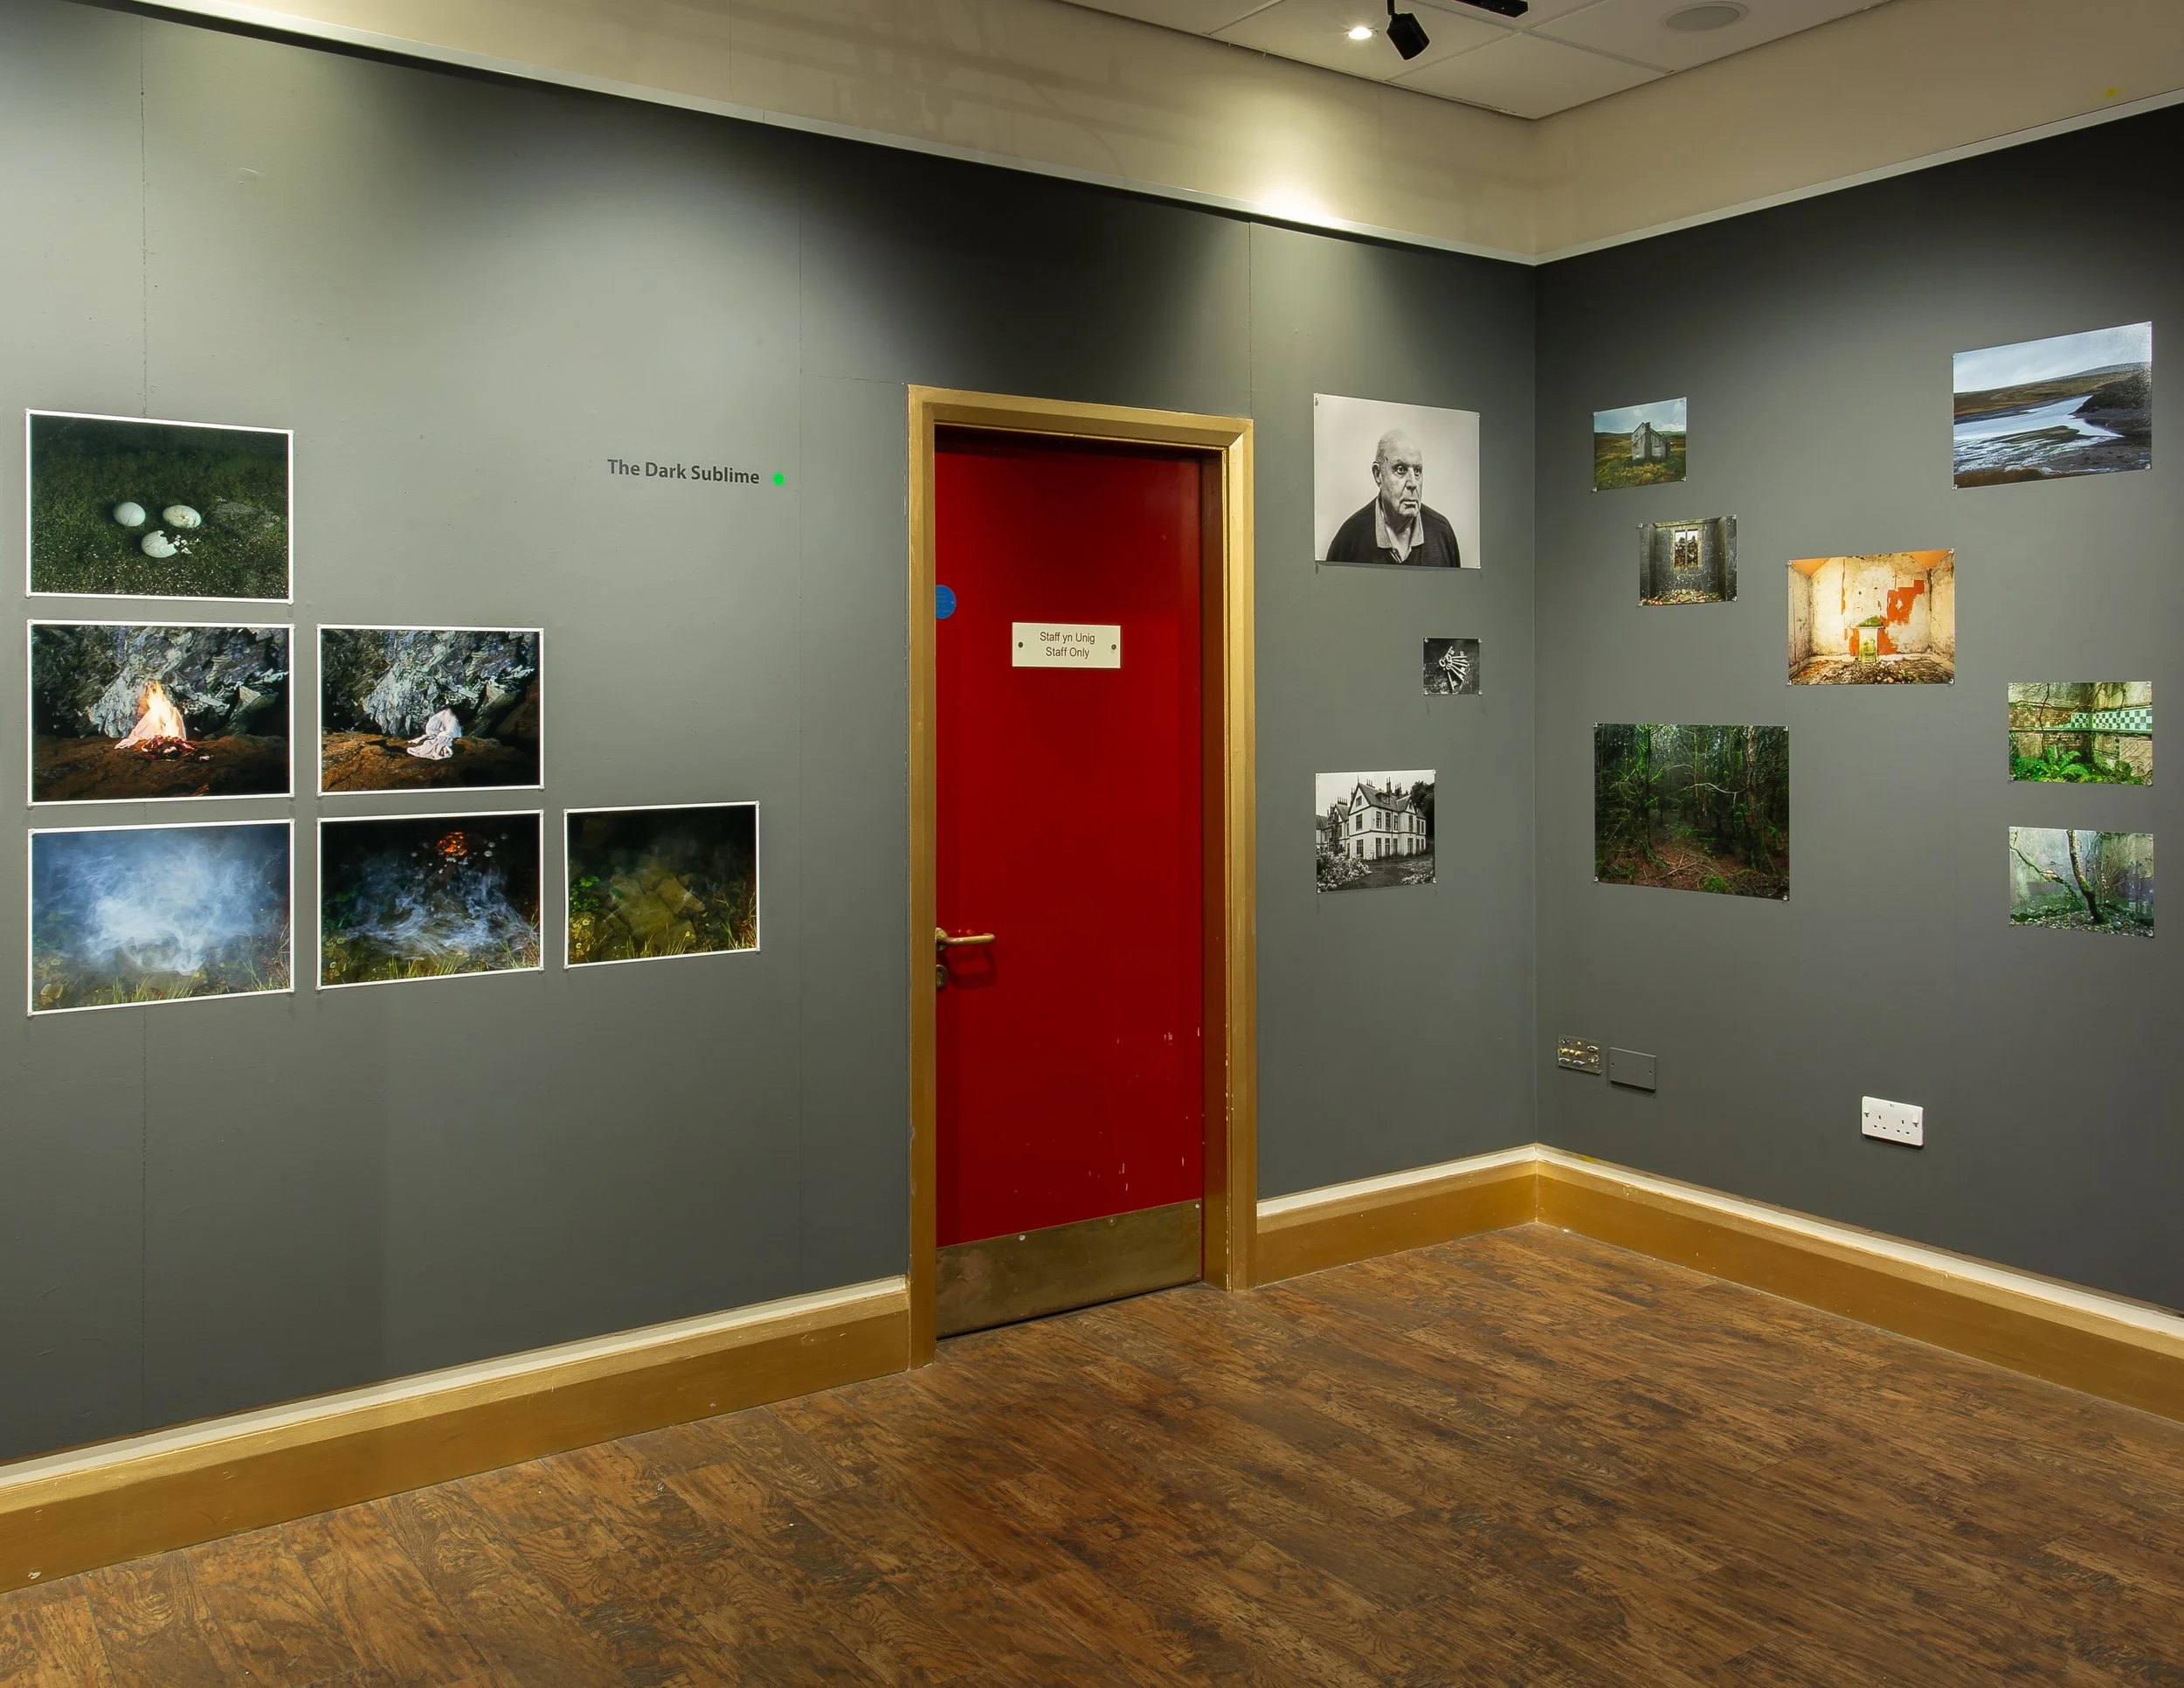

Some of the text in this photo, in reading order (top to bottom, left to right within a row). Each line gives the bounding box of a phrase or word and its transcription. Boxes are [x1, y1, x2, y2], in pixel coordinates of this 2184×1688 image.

[607, 459, 760, 484] The Dark Sublime
[1040, 631, 1095, 645] Staff yn Unig
[1046, 647, 1090, 660] Staff Only
